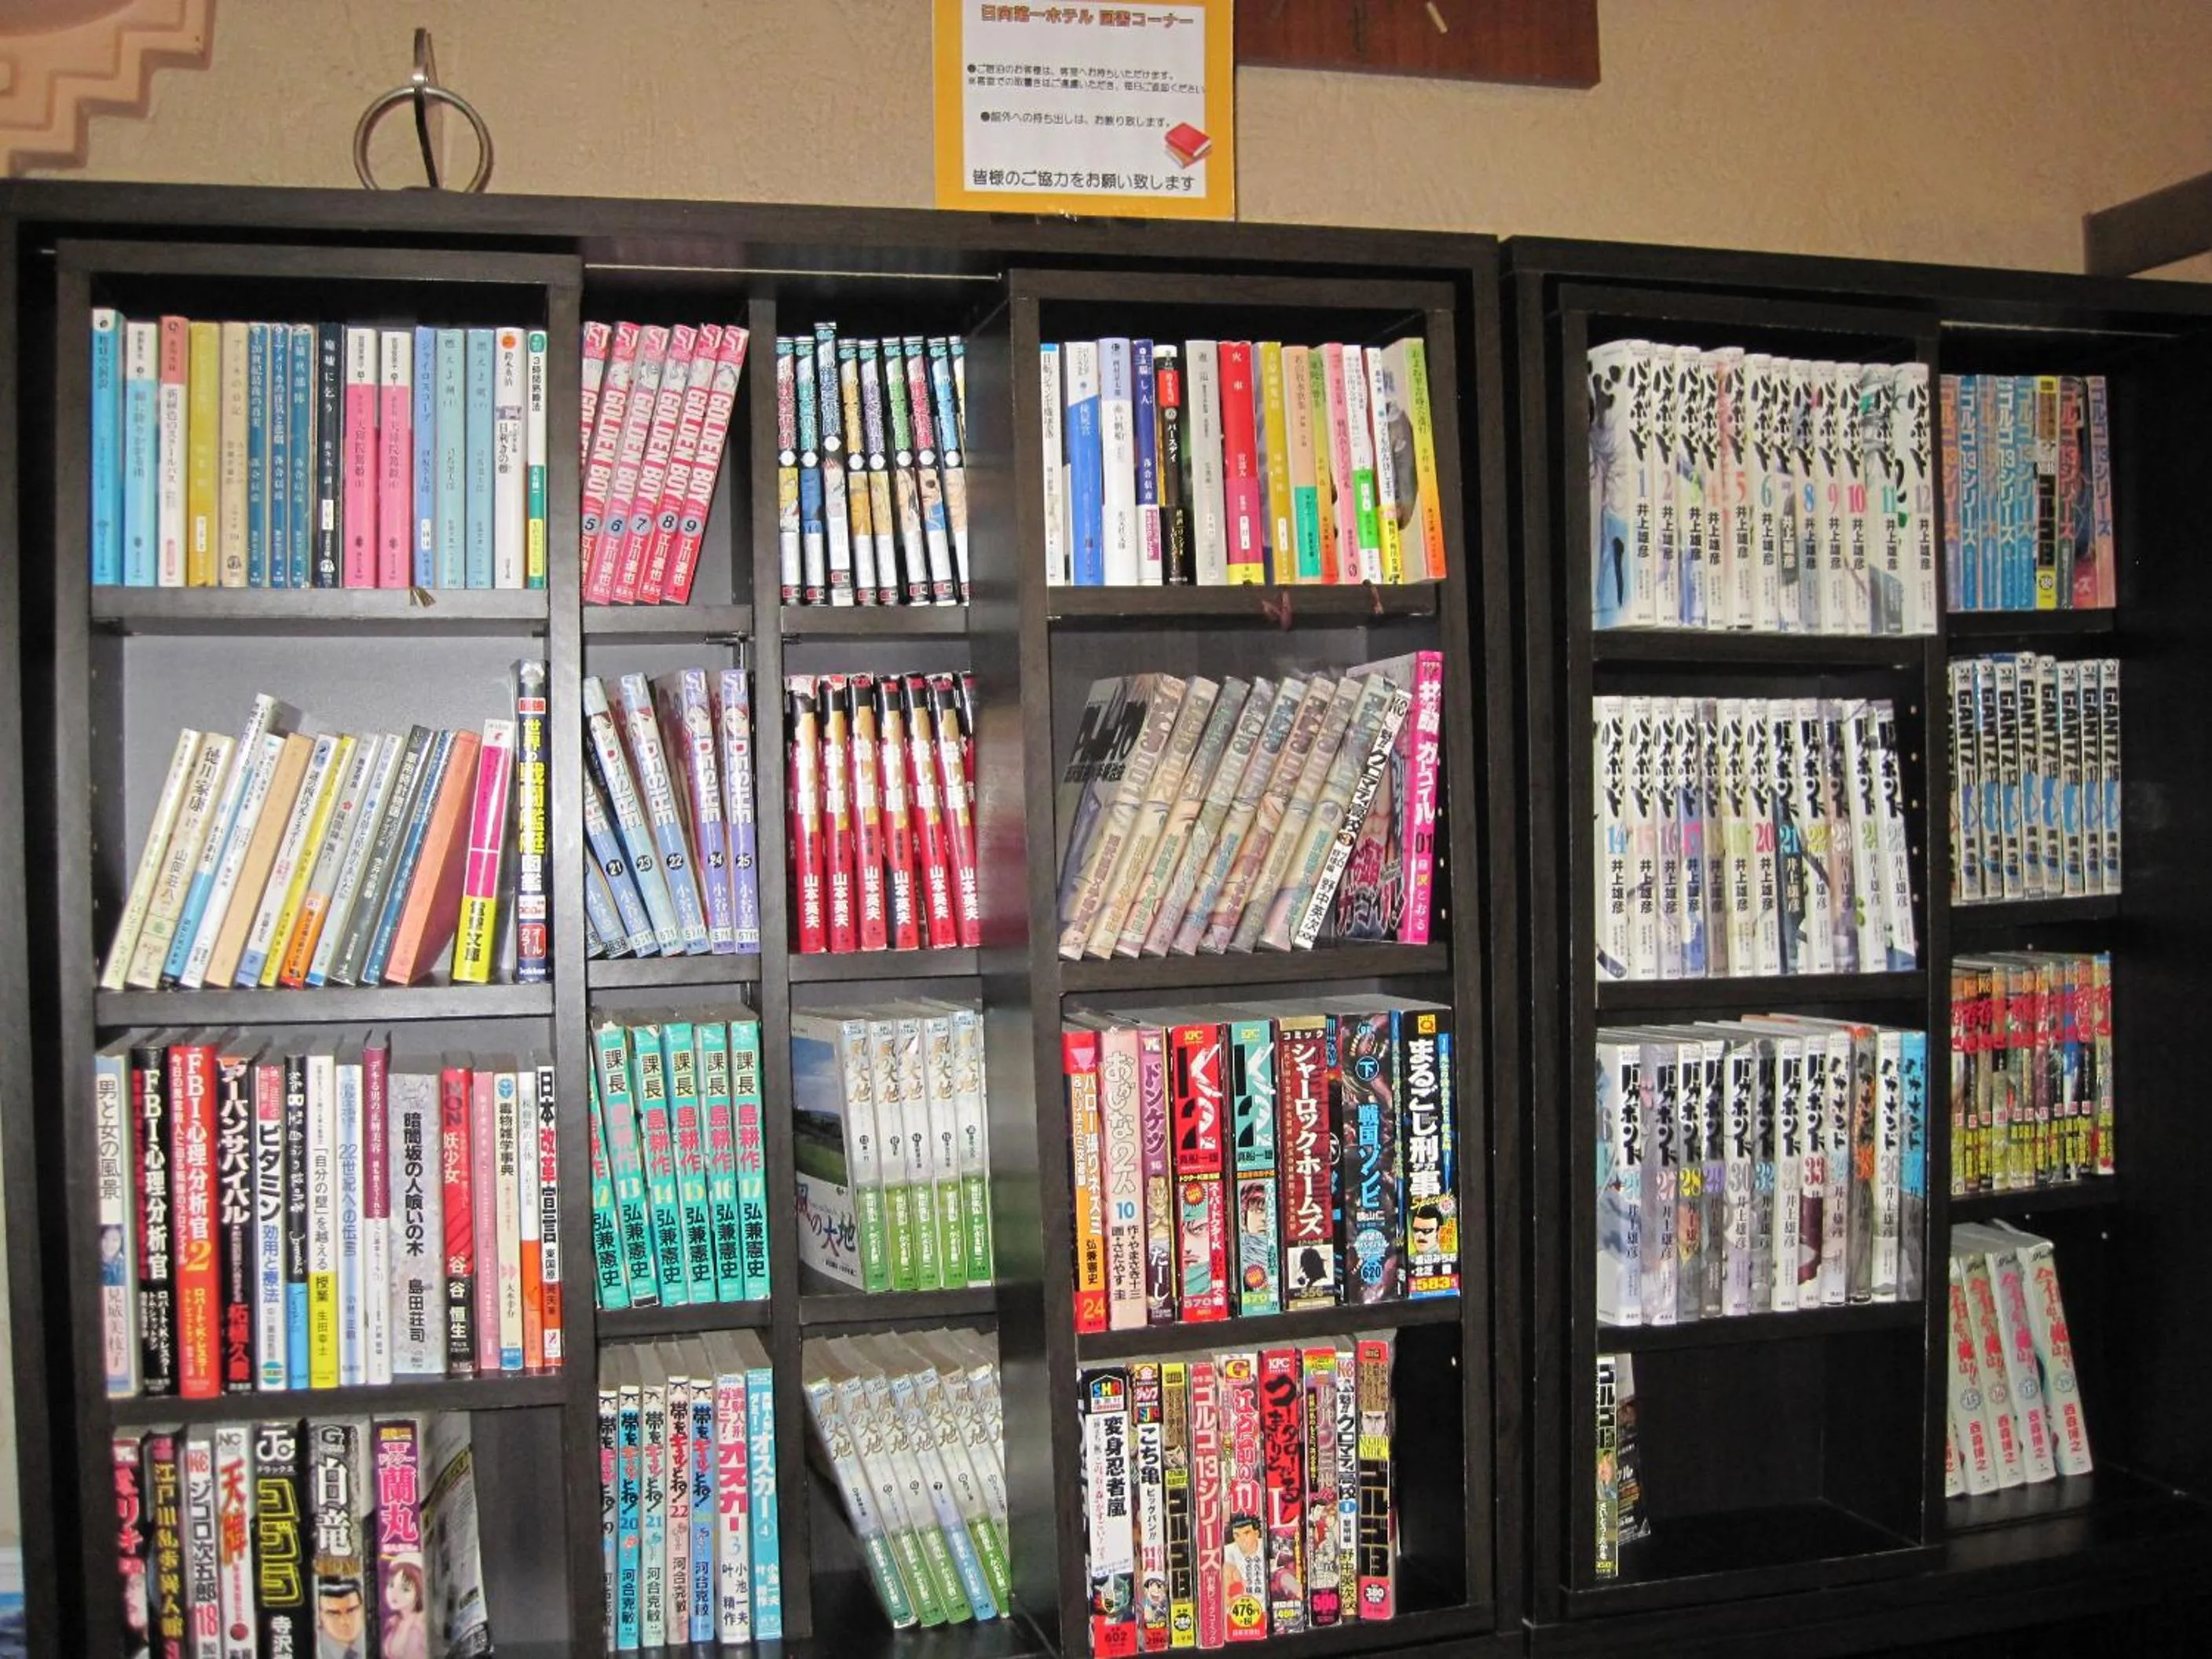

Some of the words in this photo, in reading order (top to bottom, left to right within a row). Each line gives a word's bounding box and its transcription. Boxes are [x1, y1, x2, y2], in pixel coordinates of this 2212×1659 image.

[972, 170, 1196, 191] 皆様のご協力をお願い致します
[587, 464, 612, 505] BOY
[665, 462, 690, 503] BOY
[688, 464, 716, 508] BOY
[1734, 470, 1748, 504] 5
[1804, 482, 1816, 513] 8
[1848, 483, 1867, 514] 10
[584, 517, 595, 531] 5
[610, 518, 624, 533] 6
[635, 517, 647, 533] 7
[661, 514, 675, 529] 8
[684, 518, 698, 533] 9
[1754, 822, 1777, 854] 20
[803, 873, 820, 929] 山本英夫
[863, 865, 881, 921] 山本英夫
[893, 869, 911, 926] 山本英夫
[960, 865, 979, 921] 山本英夫
[1282, 1031, 1324, 1042] コミック
[1359, 1060, 1375, 1077] 下
[1144, 1063, 1166, 1155] ドンケツ
[1407, 1038, 1443, 1197] まるごし刑事
[98, 1079, 122, 1200] 男と女の風景
[539, 1071, 559, 1243] 日本改革宣言
[1291, 1043, 1325, 1238] シャーロック・ホームズ
[1357, 1103, 1382, 1210] 戦国ゾンビ
[143, 1068, 169, 1280] FBI心理分析官
[258, 1122, 283, 1222] ビタミン
[403, 1111, 425, 1258] 暗闇坂の人喰いの木
[1679, 1167, 1702, 1198] 28
[1116, 1200, 1136, 1220] 10
[594, 1211, 621, 1288] 弘兼憲史
[656, 1208, 683, 1285] 弘兼憲史
[716, 1204, 739, 1280] 弘兼憲史
[1362, 1265, 1382, 1278] 620
[1416, 1276, 1452, 1292] 583
[408, 1279, 427, 1343] 島田荘司
[1082, 1298, 1105, 1319] 24
[1103, 1415, 1127, 1518] 変身忍者嵐
[1140, 1426, 1161, 1485] こち亀
[1193, 1386, 1221, 1571] ゴルゴ13シリーズ
[315, 1456, 353, 1558] 白竜
[379, 1465, 419, 1543] 蘭丸
[670, 1503, 689, 1518] 22
[718, 1441, 747, 1532] オスカー
[190, 1478, 218, 1605] ジゴロ次五郎
[620, 1515, 639, 1530] 20
[645, 1514, 663, 1528] 21
[621, 1568, 636, 1624] 河合克敏
[672, 1555, 687, 1613] 河合克敏
[694, 1560, 709, 1617] 河合克敏
[722, 1563, 736, 1626] 叶精作
[734, 1562, 749, 1626] 小池一夫
[1365, 1588, 1384, 1599] 380
[195, 1604, 218, 1637] 18
[1104, 1632, 1129, 1643] 602
